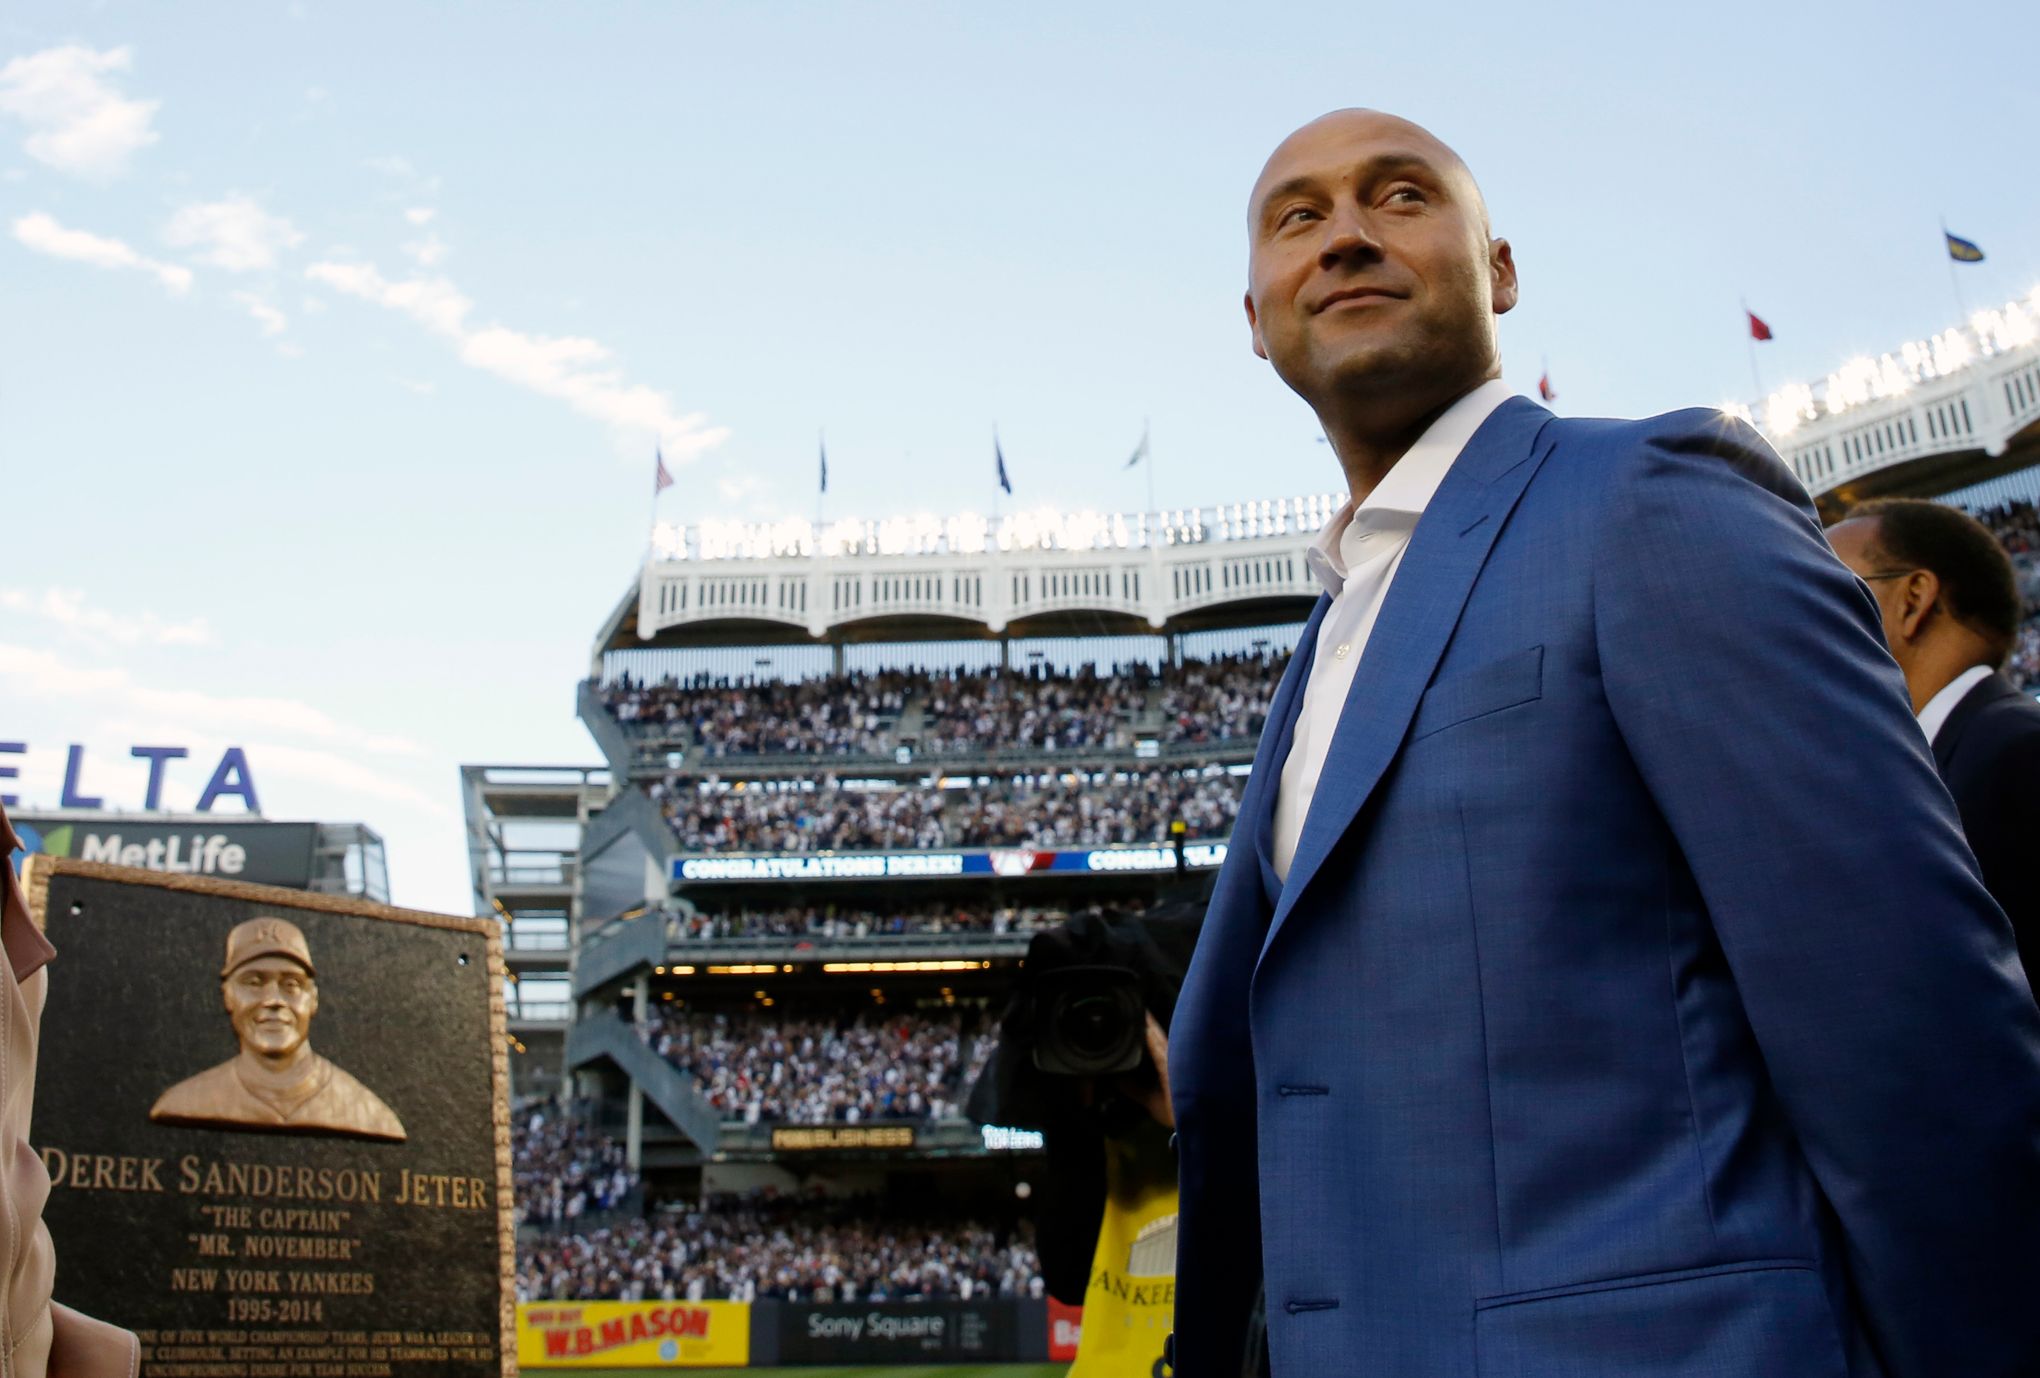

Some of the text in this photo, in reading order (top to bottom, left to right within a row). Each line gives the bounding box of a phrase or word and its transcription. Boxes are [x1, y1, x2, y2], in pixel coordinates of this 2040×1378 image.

[0, 742, 259, 811] ELTA
[81, 834, 246, 874] MetLife
[682, 857, 885, 879] CONGRATULATIONS
[40, 1147, 487, 1210] DEREK SANDERSON JETER
[171, 1267, 375, 1295] NEW YORK YANKEES
[228, 1298, 323, 1322] 1995-2014
[808, 1312, 864, 1342] Sony
[866, 1311, 946, 1342] Square
